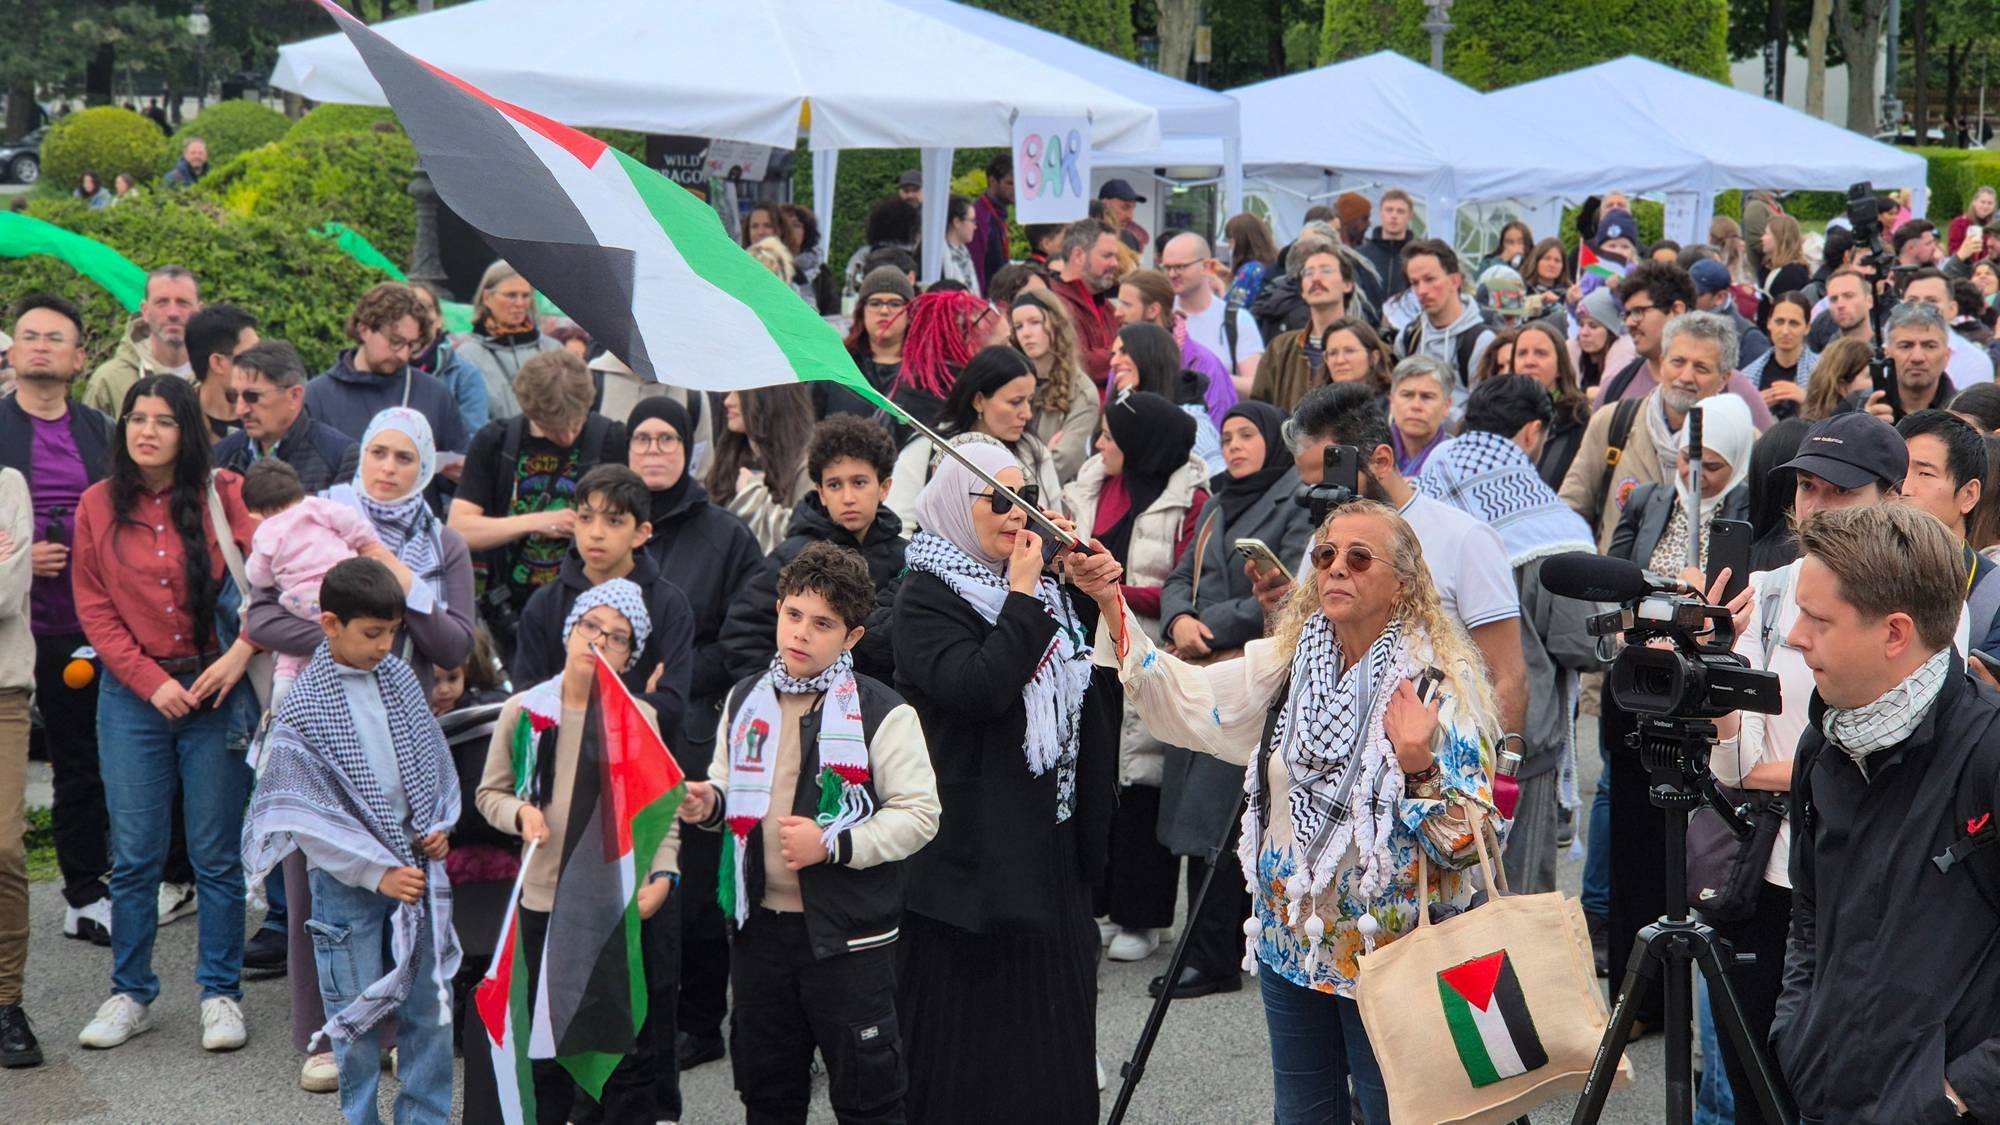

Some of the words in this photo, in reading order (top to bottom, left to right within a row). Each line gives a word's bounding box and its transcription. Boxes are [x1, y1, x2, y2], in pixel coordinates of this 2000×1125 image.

[663, 153, 700, 166] WILD
[1019, 129, 1082, 200] BAR
[659, 168, 707, 184] RAGO
[1743, 688, 1757, 696] 4K
